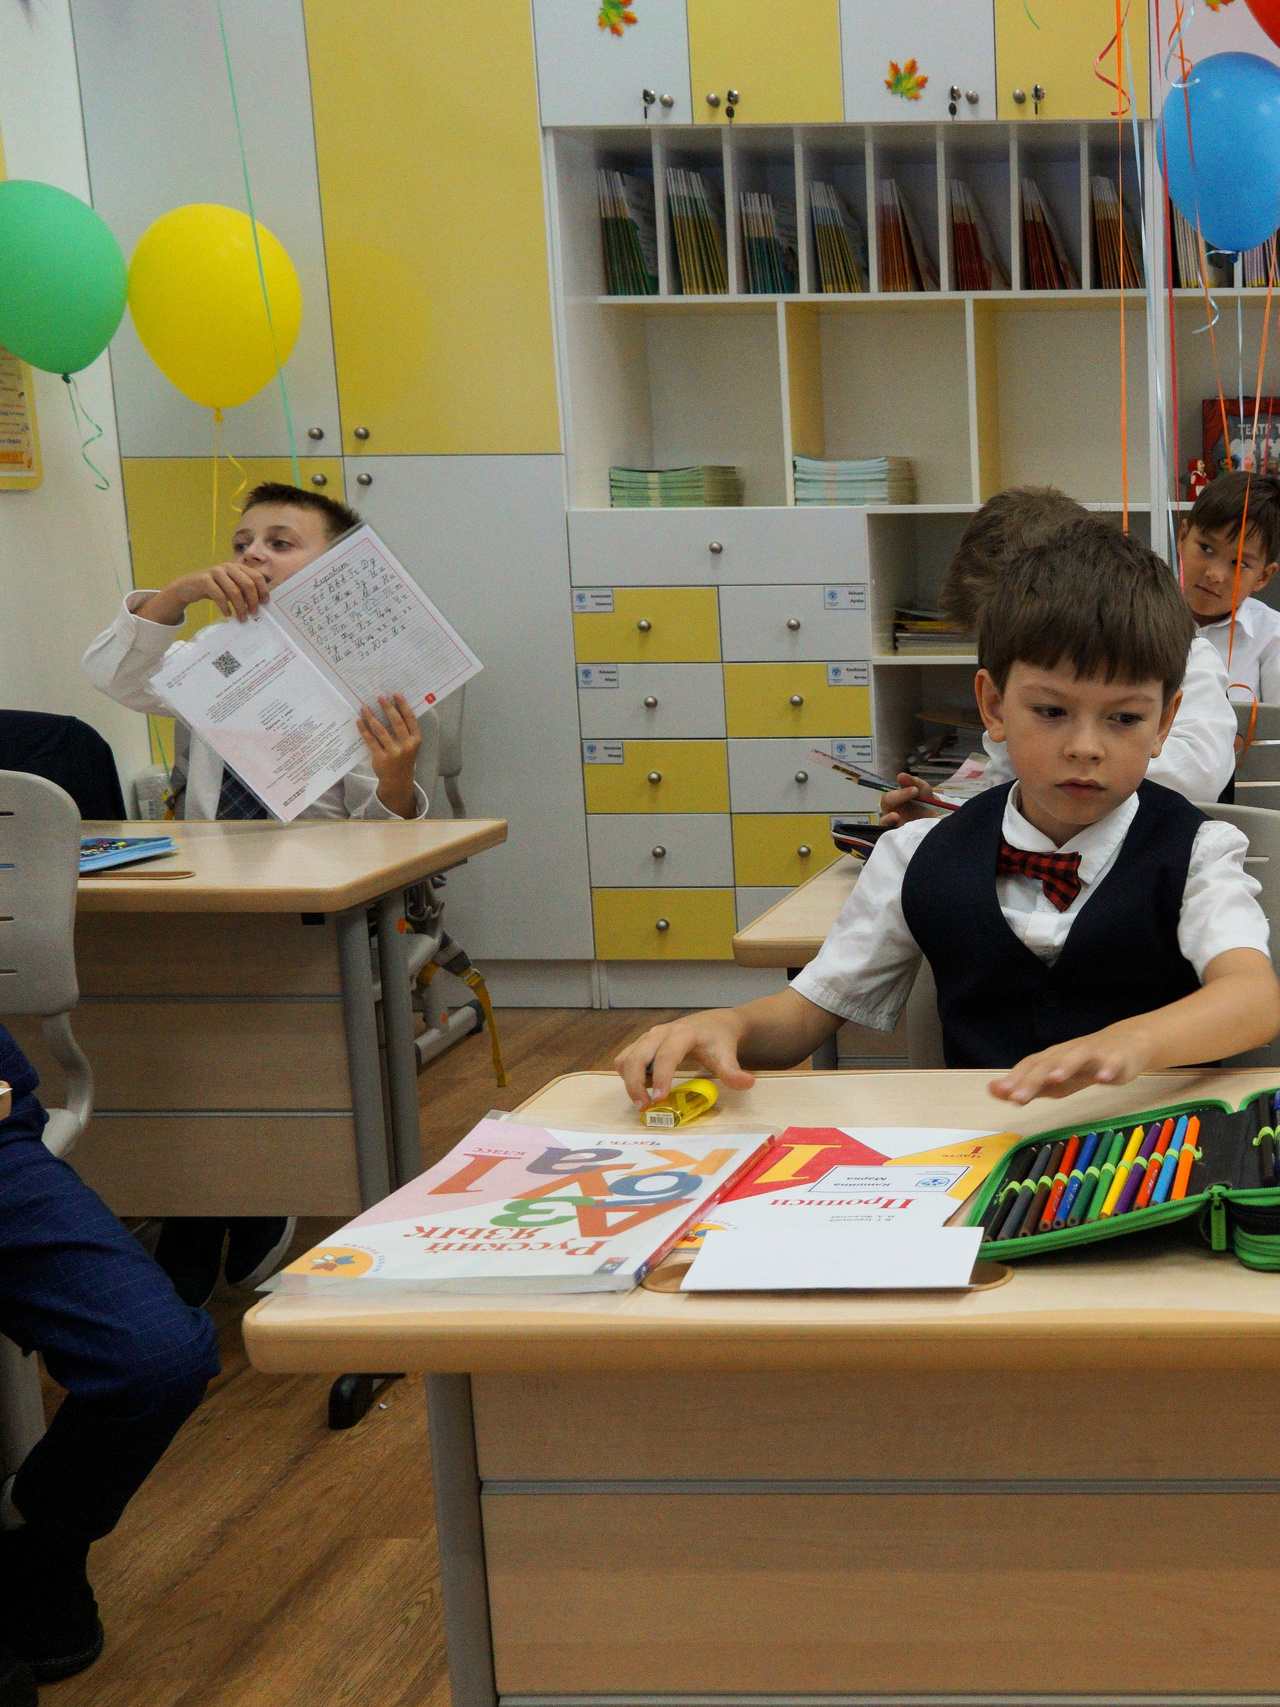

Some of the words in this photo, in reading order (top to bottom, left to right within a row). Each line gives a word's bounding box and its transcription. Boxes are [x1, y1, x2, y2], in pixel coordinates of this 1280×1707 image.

[476, 1147, 526, 1156] класс
[752, 1144, 843, 1184] 1
[426, 1153, 522, 1195] 1
[770, 1196, 920, 1210] Прописи
[404, 1226, 547, 1240] язык
[424, 1238, 612, 1256] Русский
